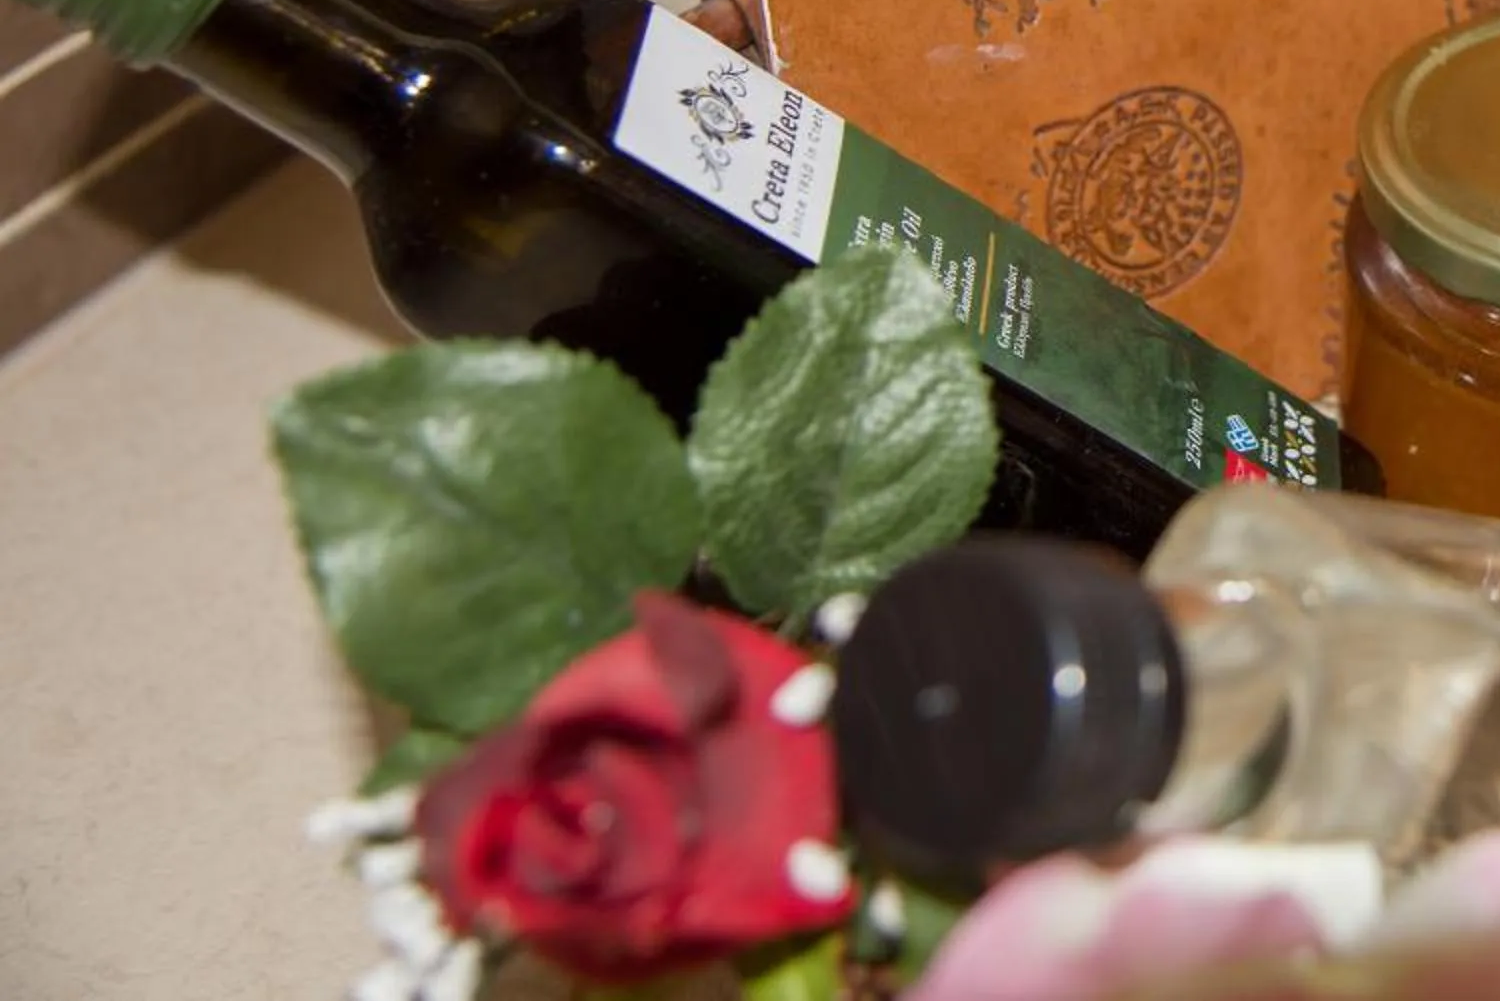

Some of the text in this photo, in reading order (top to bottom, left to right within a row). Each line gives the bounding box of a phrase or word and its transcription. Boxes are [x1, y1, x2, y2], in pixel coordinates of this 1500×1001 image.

[752, 90, 804, 225] Creta Eleon
[848, 215, 872, 249] xtra
[901, 206, 923, 239] Oil
